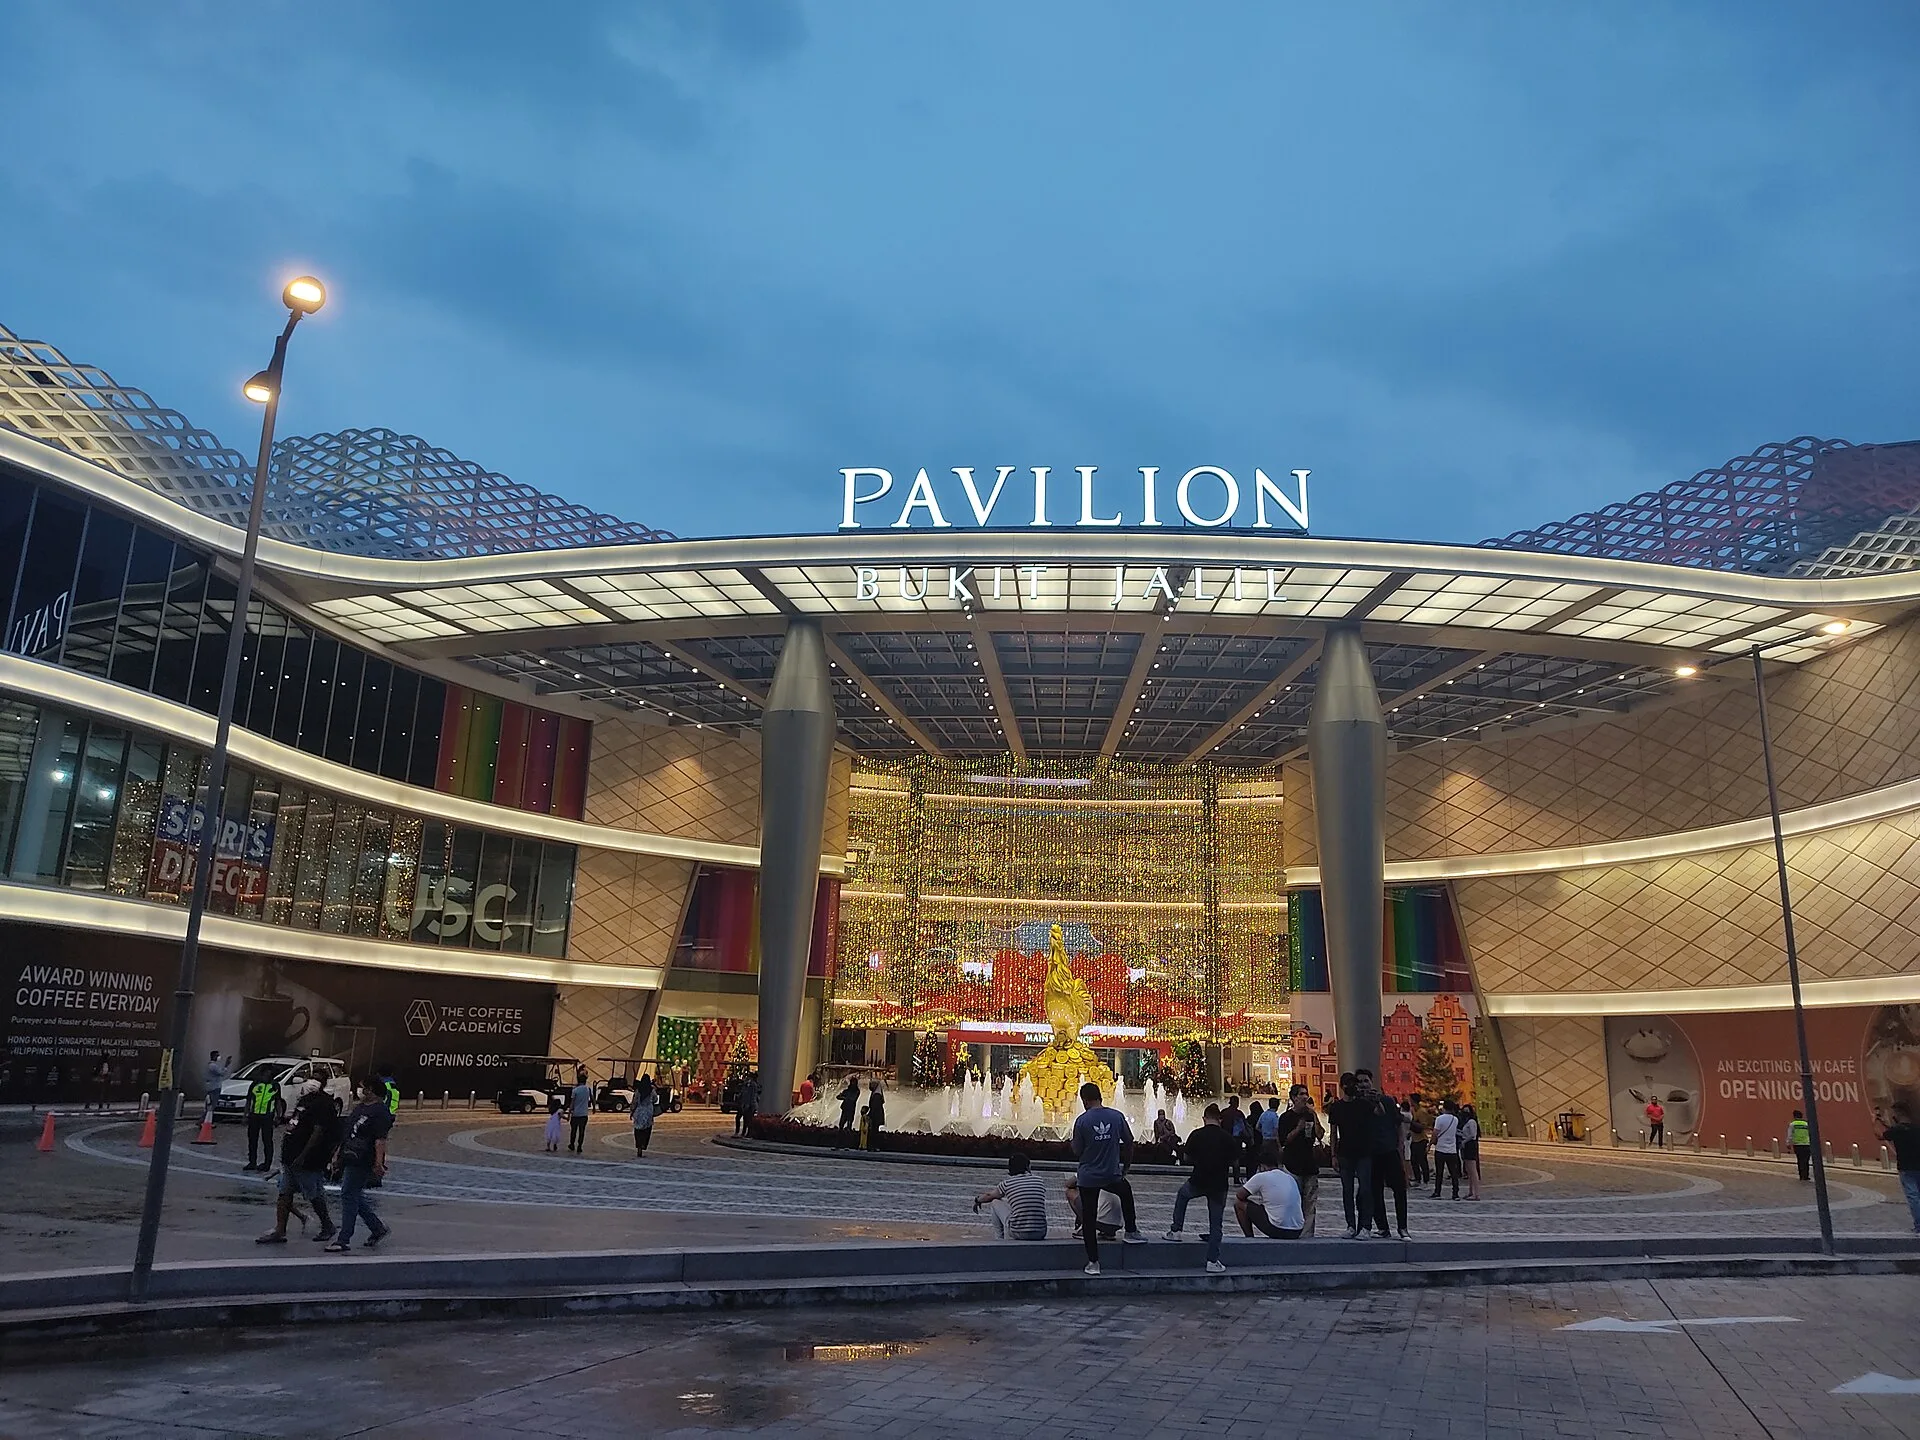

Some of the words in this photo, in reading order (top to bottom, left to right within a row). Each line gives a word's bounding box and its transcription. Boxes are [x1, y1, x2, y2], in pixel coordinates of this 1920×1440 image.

[838, 466, 1311, 528] PAVILION
[856, 566, 1047, 601] BUKIT
[1111, 566, 1287, 606] JALIL
[158, 850, 260, 896] DIECT
[384, 866, 517, 942] USC
[19, 965, 85, 986] AWARD
[89, 970, 153, 992] WINNING
[16, 988, 87, 1009] COFFEE
[89, 992, 160, 1013] EVERYDAY
[440, 1006, 465, 1017] THE
[468, 1006, 523, 1019] COFFEE
[43, 1017, 57, 1025] and
[57, 1017, 81, 1026] Roaster
[82, 1018, 89, 1026] of
[115, 1020, 132, 1028] Coffee
[438, 1020, 521, 1034] ACADEMÏCS
[7, 1035, 30, 1044] HONG
[31, 1036, 53, 1045] KONG
[58, 1036, 96, 1046] SINGAPORE
[100, 1038, 129, 1047] MALAYSIA
[1025, 1033, 1049, 1043] MAIN
[58, 1047, 80, 1056] CHINA
[120, 1049, 139, 1057] KOREA
[419, 1053, 474, 1067] OPENING
[1717, 1060, 1734, 1072] AN
[1738, 1060, 1791, 1073] EXCITING
[1795, 1060, 1821, 1073] NW
[1824, 1056, 1856, 1074] CAFÉ
[1719, 1079, 1803, 1101] OPENING
